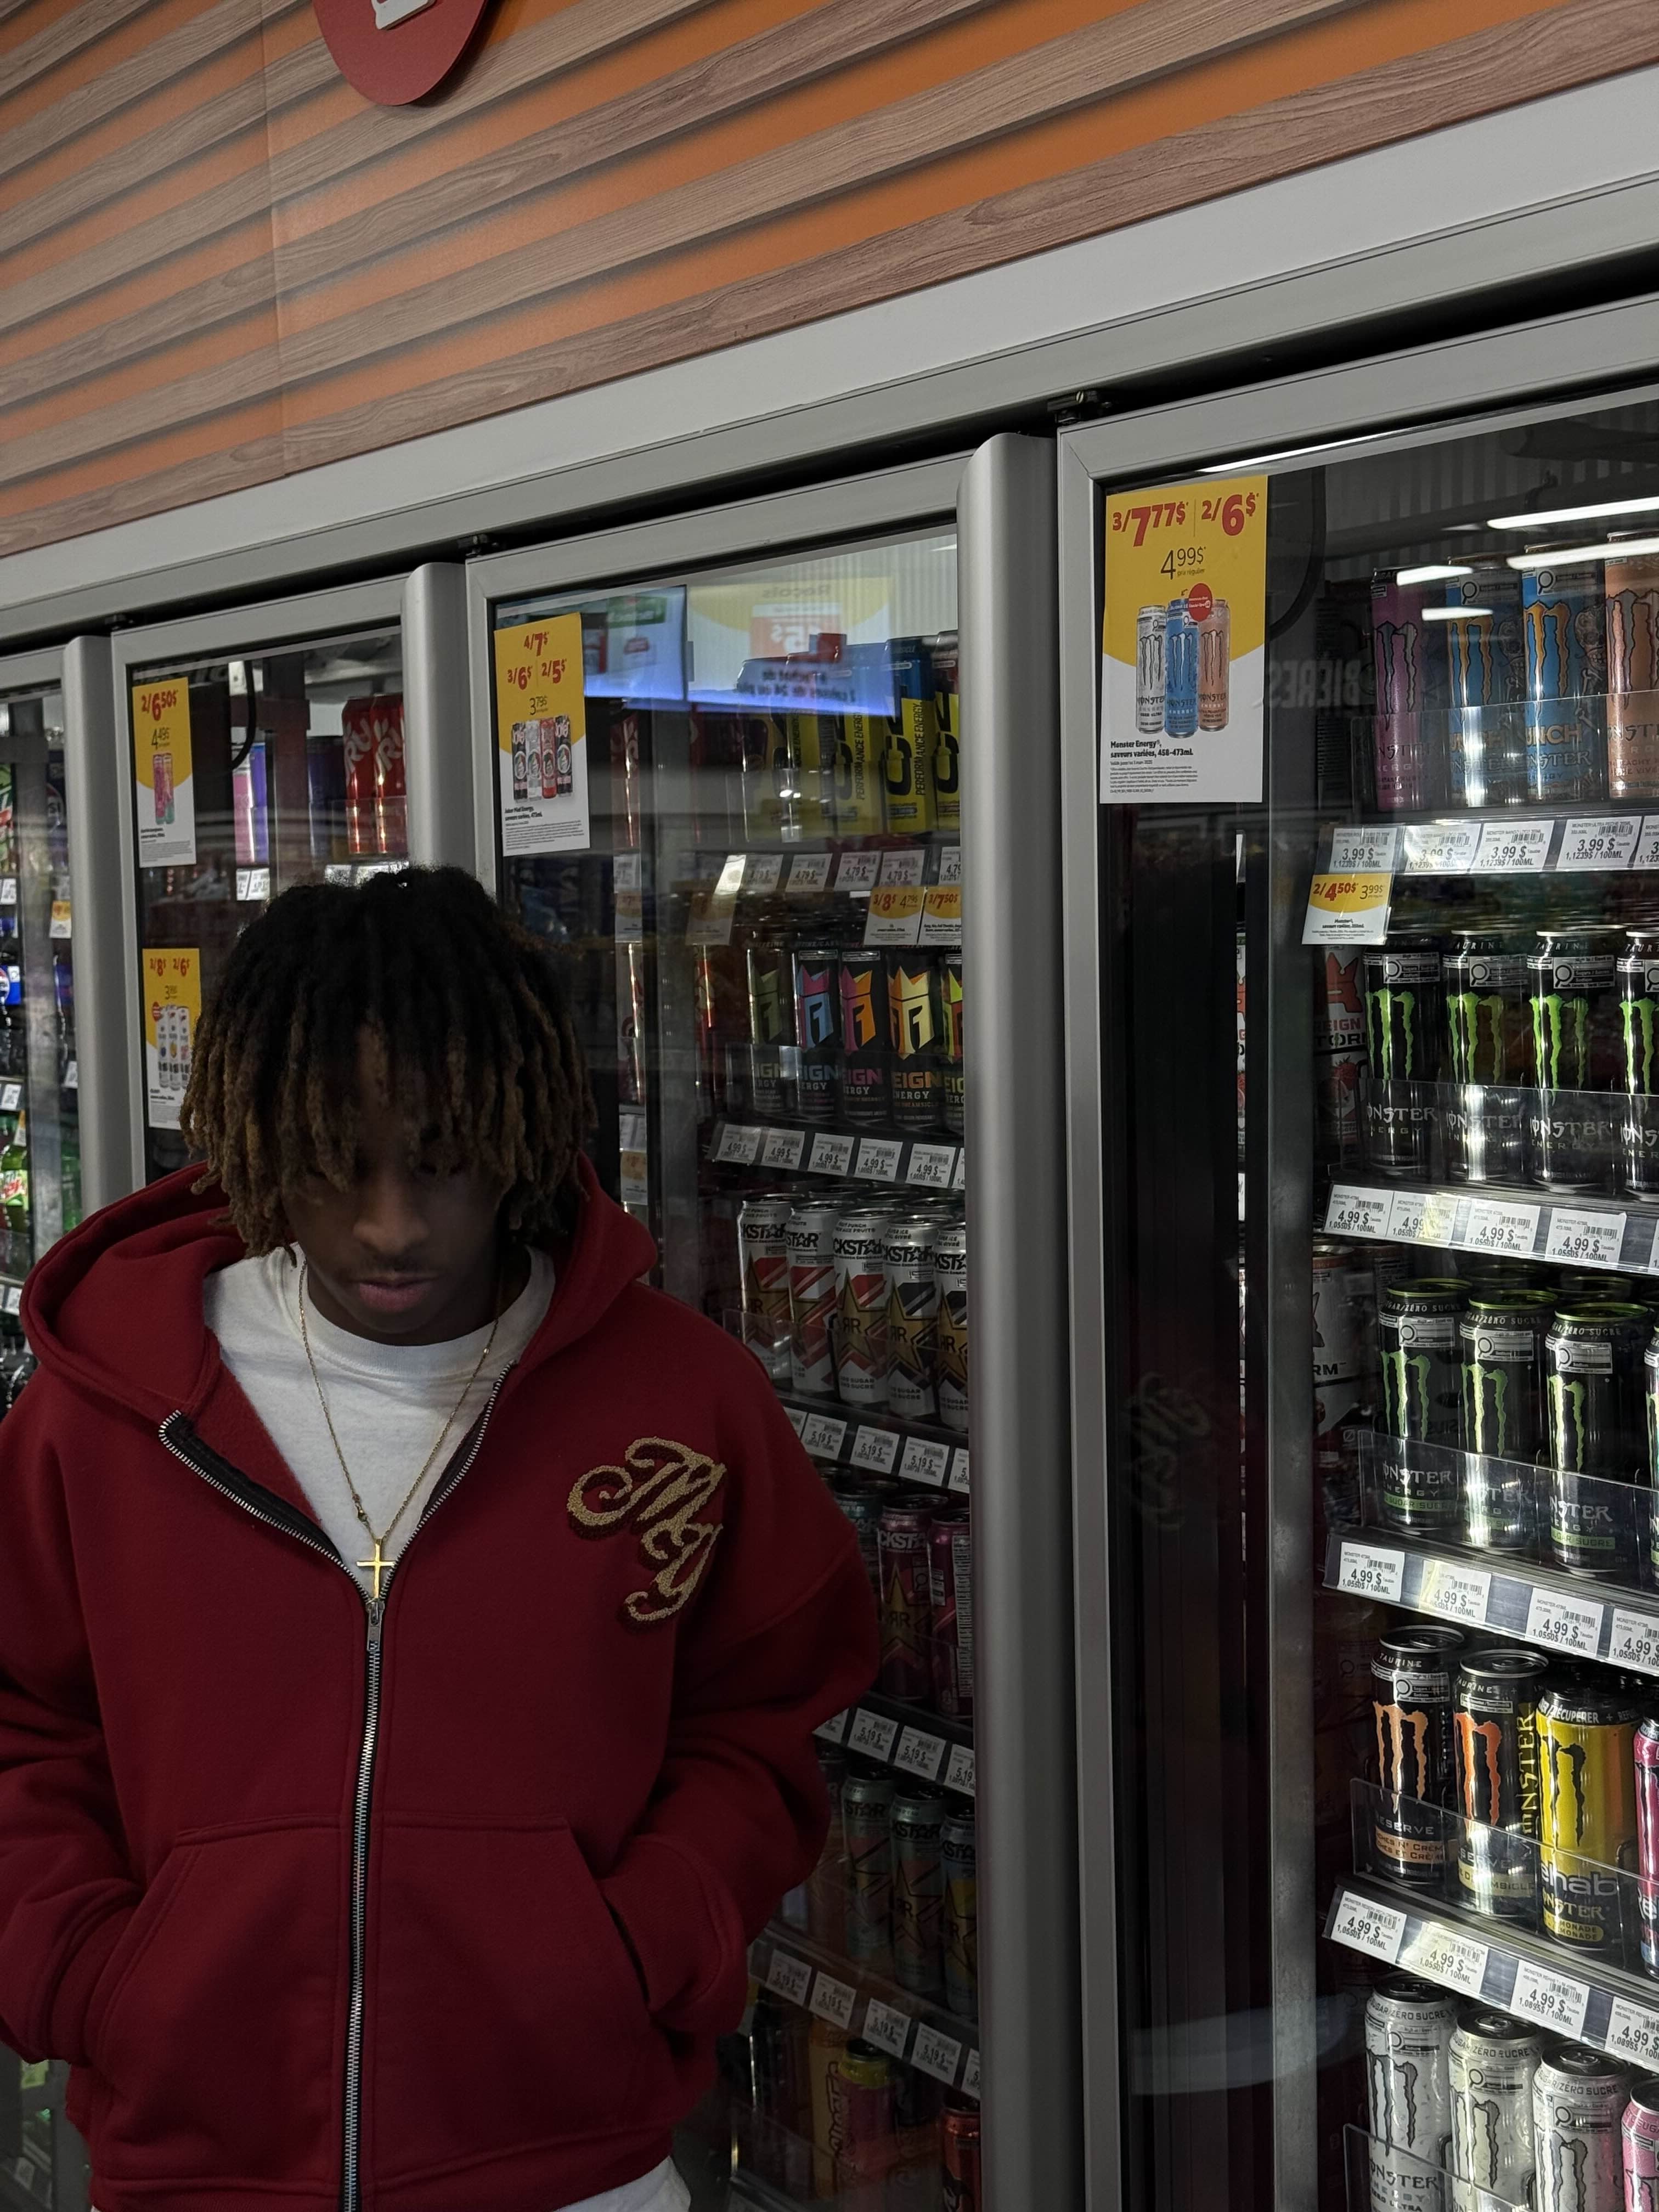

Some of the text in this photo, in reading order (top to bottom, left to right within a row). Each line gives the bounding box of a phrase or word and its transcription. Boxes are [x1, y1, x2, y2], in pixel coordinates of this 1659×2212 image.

[854, 712, 865, 740] ENERG
[913, 736, 927, 795] PERFORMANCE
[1607, 838, 1615, 851] $
[1367, 848, 1374, 861] $
[1519, 845, 1526, 858] $
[1599, 850, 1623, 859] 100ML
[861, 866, 866, 877] $
[904, 870, 909, 880] $
[786, 1148, 791, 1158] $
[833, 1154, 839, 1165] $
[880, 1159, 885, 1170] $
[934, 1165, 939, 1177] $
[1362, 1212, 1369, 1225] $
[1507, 1228, 1514, 1242] $
[1593, 1239, 1600, 1253] $
[827, 1434, 832, 1446] $
[878, 1446, 883, 1457] $
[928, 1458, 934, 1469] $
[1376, 1572, 1382, 1585] $
[1370, 1583, 1391, 1594] 100ML
[1461, 1594, 1468, 1607] $
[1571, 1626, 1579, 1639] $
[1565, 1637, 1588, 1651] 100ML
[1379, 1652, 1423, 1668] TAURINE
[1456, 1674, 1493, 1694] TAURINE
[877, 1731, 882, 1743] $
[921, 1751, 927, 1762] $
[1379, 1815, 1435, 1835] ESERVE
[1373, 1926, 1381, 1938] $
[1366, 1935, 1387, 1951] 100ML
[1458, 1960, 1464, 1973] $
[1450, 1968, 1472, 1985] 100ML
[1558, 1999, 1566, 2013] $
[1415, 2011, 1446, 2020] SUCRE
[1551, 2010, 1573, 2026] 100ML
[1586, 2085, 1619, 2096] SUCRE
